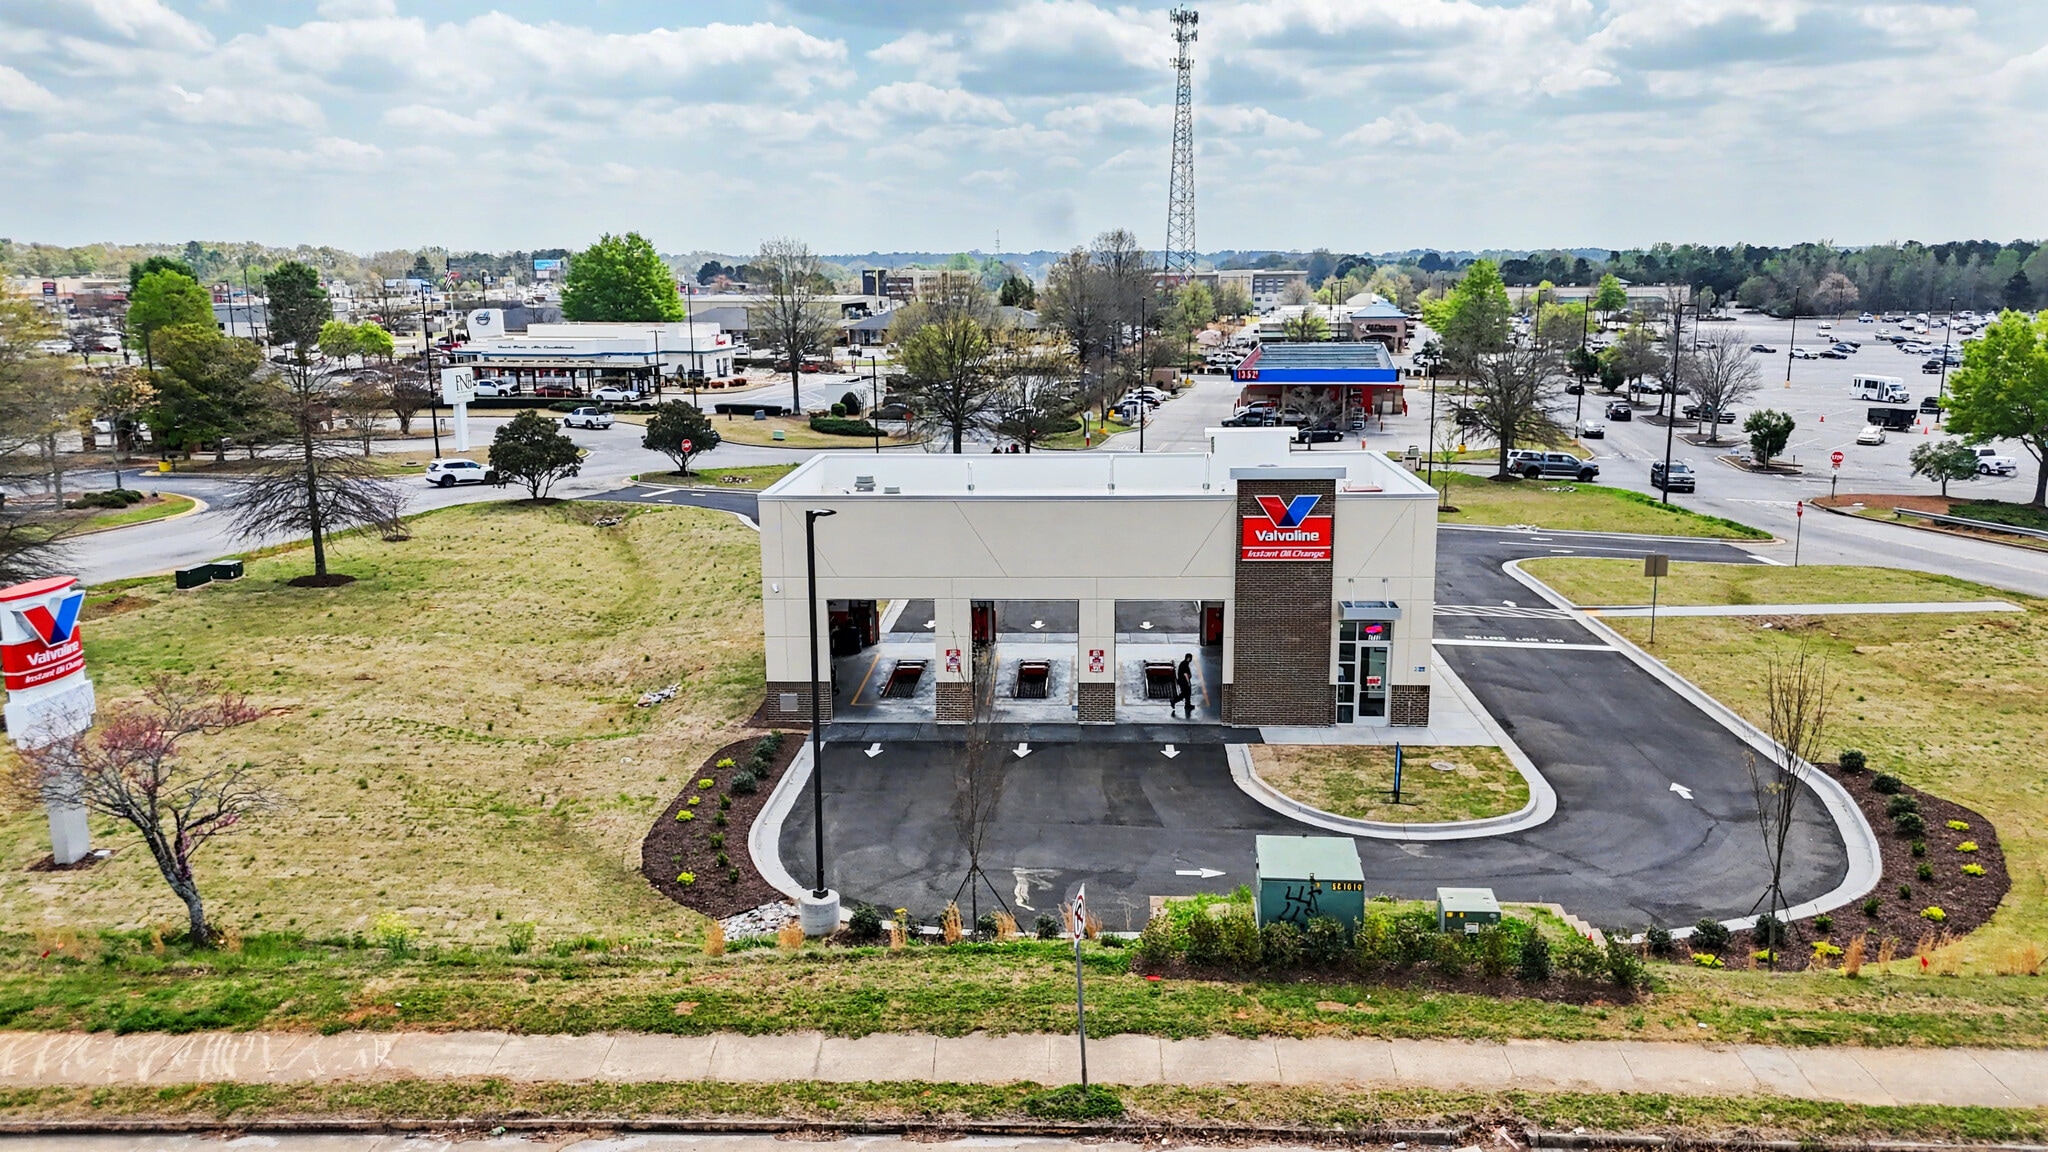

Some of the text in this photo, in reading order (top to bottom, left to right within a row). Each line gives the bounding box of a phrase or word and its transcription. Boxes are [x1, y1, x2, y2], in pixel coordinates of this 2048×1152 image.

[1255, 530, 1320, 541] Valvoline
[1292, 550, 1325, 558] Change
[26, 641, 80, 666] Valvoline
[24, 667, 55, 684] Instant
[55, 664, 66, 675] Oil
